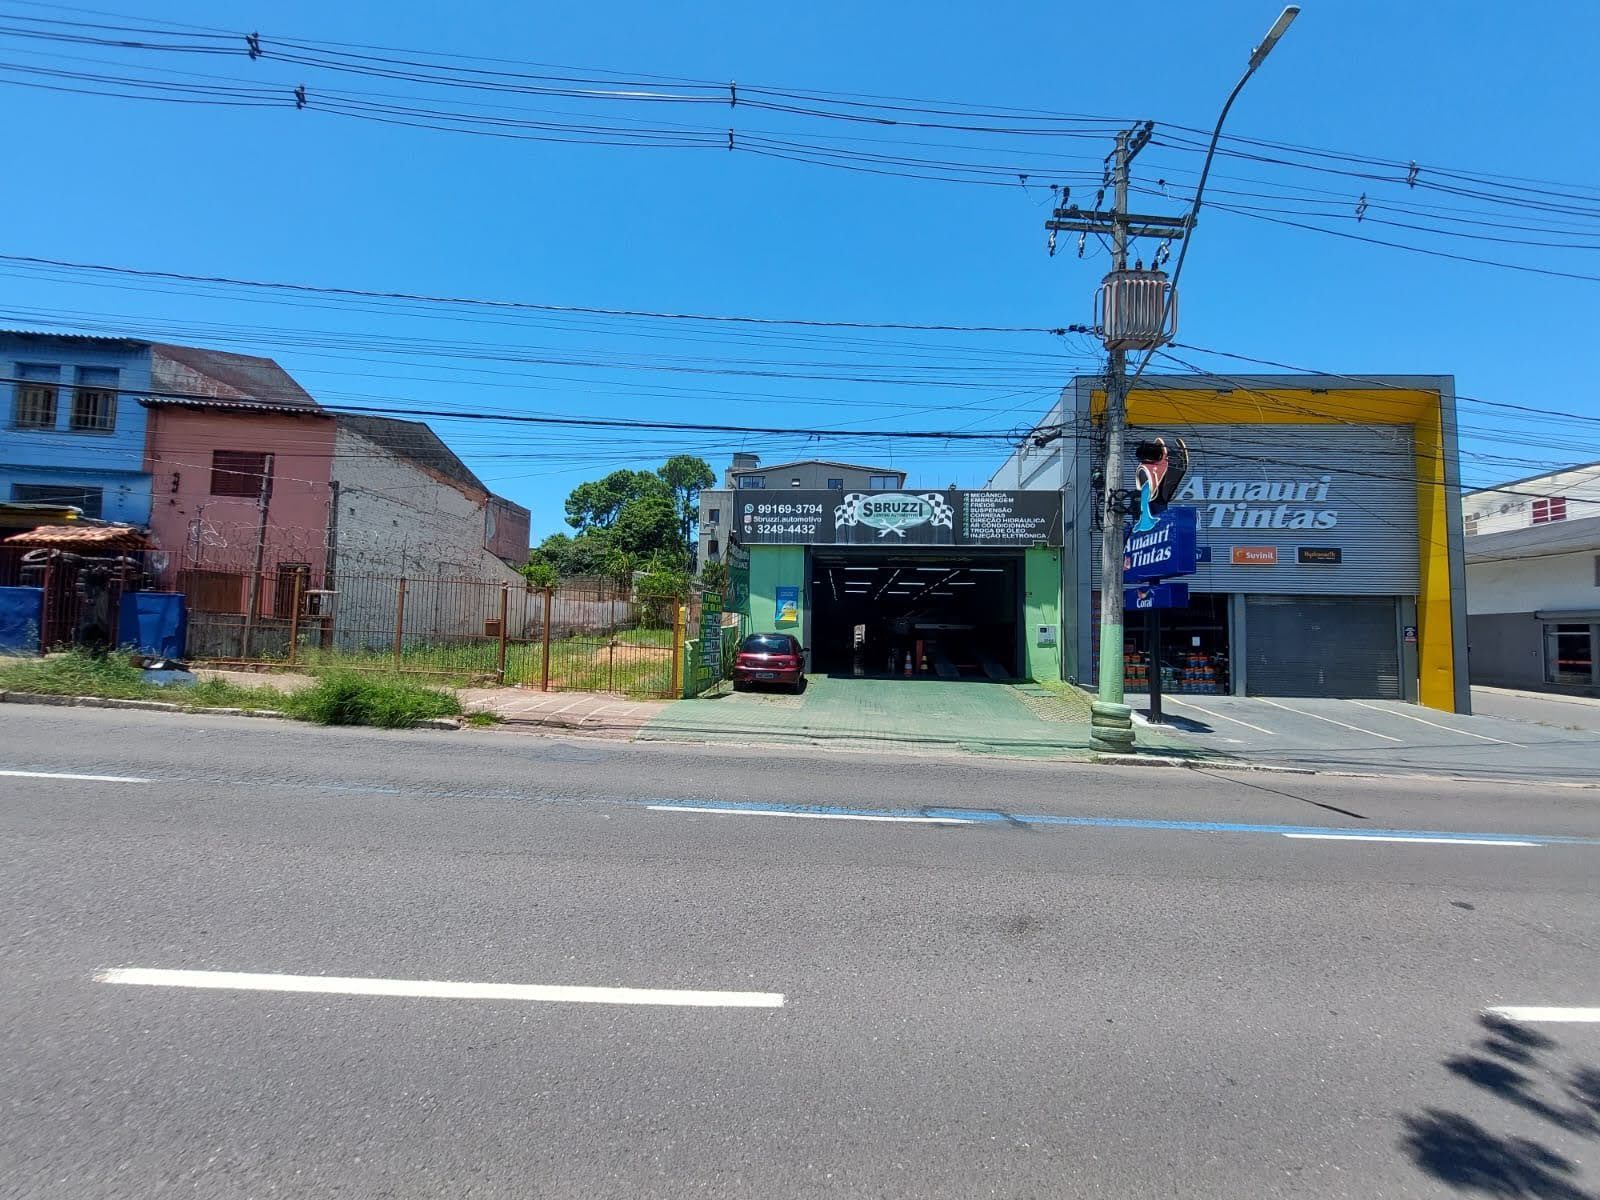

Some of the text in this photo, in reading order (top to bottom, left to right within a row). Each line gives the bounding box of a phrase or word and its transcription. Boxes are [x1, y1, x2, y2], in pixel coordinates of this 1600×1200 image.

[1176, 476, 1332, 501] Amauri
[757, 504, 823, 514] 99169-3794
[1207, 503, 1338, 529] Tintas
[757, 524, 815, 534] 3249-4432
[1122, 524, 1170, 553] Amauri
[1131, 546, 1172, 568] Tintas
[1246, 551, 1274, 559] Suvinil
[1136, 598, 1153, 608] Coral
